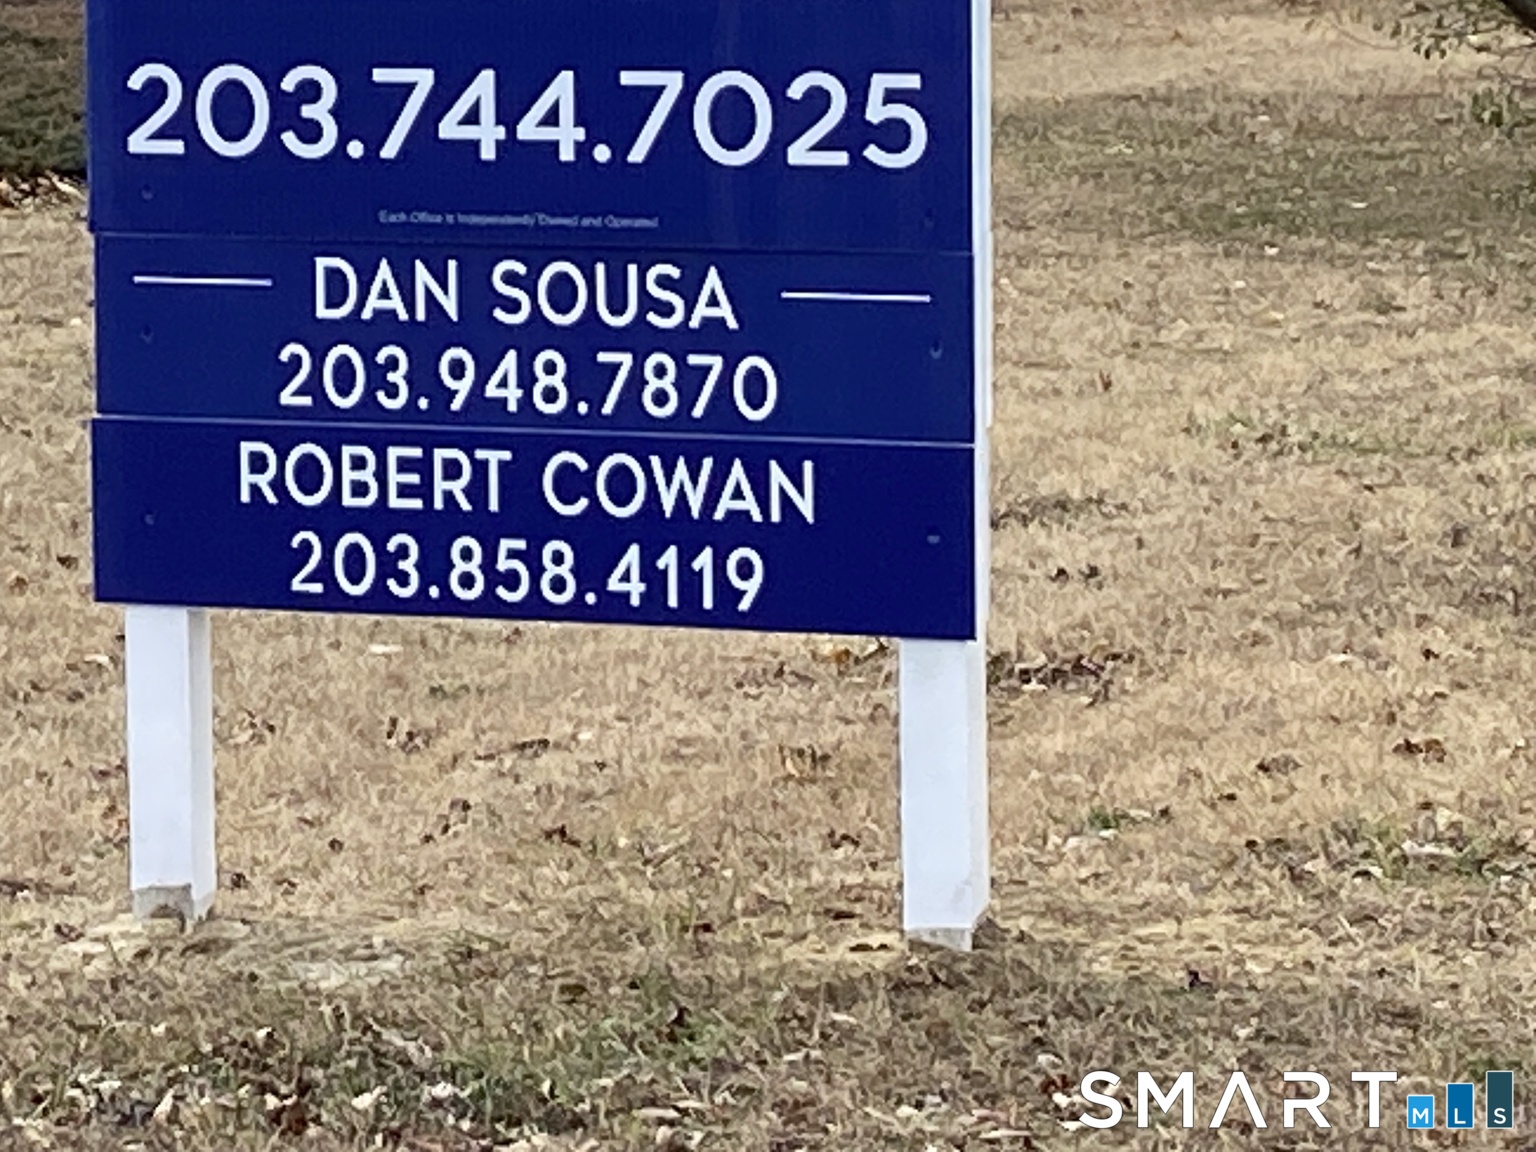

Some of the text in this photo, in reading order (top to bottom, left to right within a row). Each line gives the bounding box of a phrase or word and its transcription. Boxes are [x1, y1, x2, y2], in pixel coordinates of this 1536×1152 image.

[125, 62, 929, 168] 203.744.7025
[580, 216, 603, 228] and
[314, 257, 739, 331] DAN SOUSA
[278, 343, 778, 422] 203.948.7870
[238, 441, 816, 524] ROBERT COWAN
[290, 532, 765, 612] 203.858.4119
